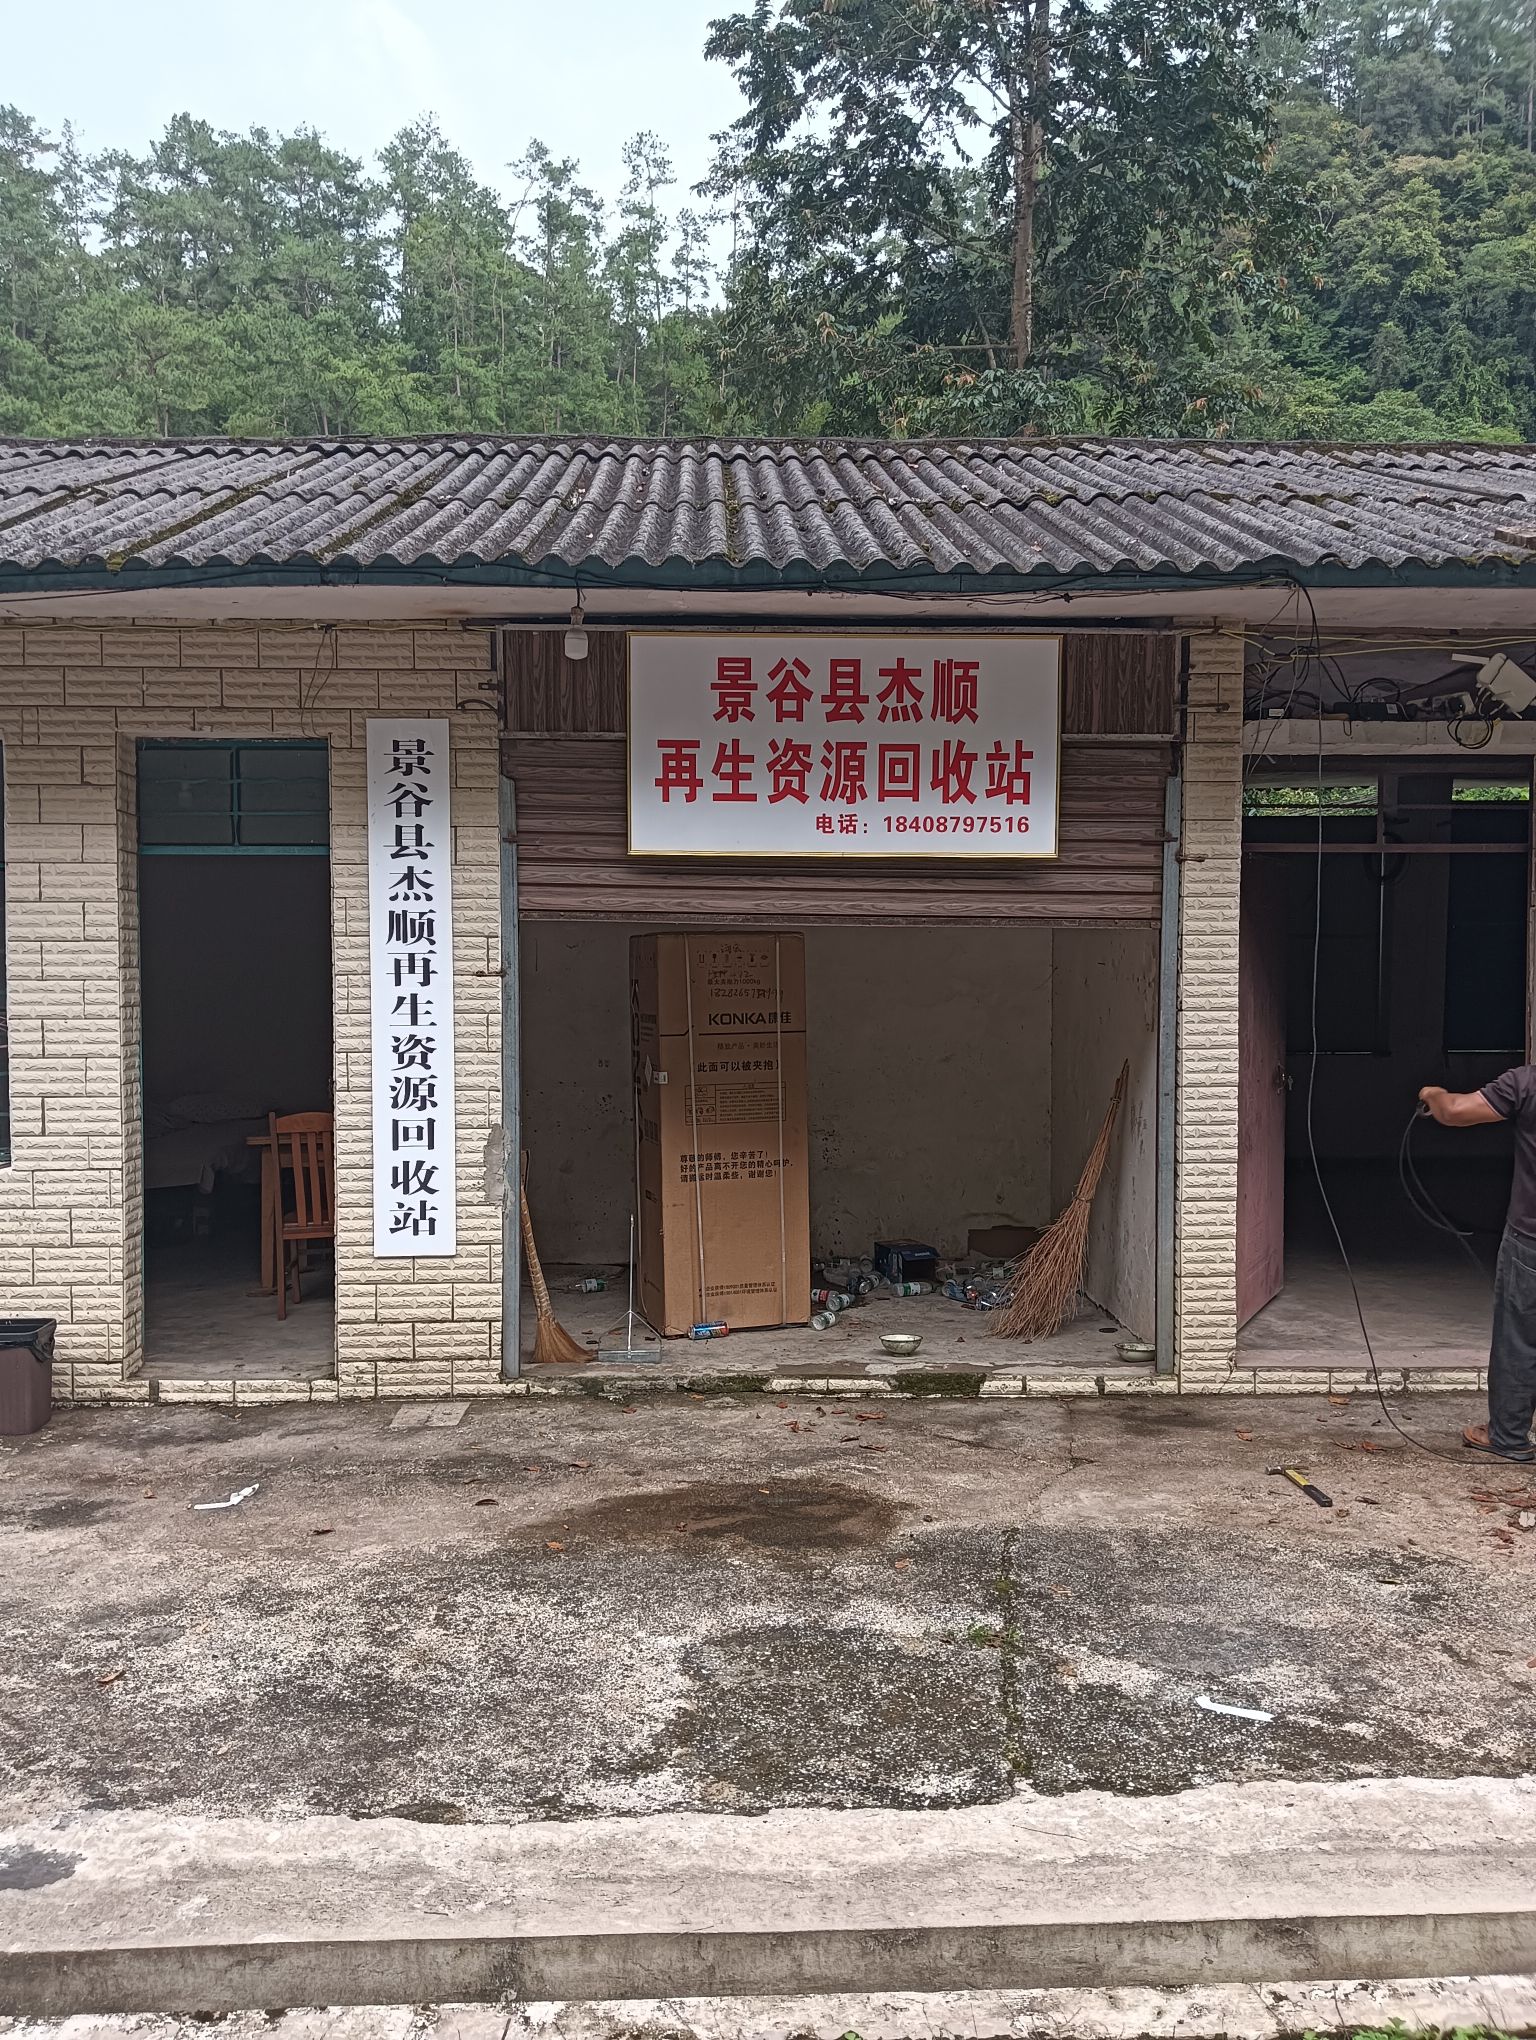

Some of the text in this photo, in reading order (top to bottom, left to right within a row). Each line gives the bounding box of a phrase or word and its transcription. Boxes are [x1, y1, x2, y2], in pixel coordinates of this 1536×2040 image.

[710, 656, 981, 725] 景谷县杰顺
[655, 738, 1034, 805] 再生资源回收站
[815, 813, 1030, 835] 电话：18408797516
[383, 739, 438, 1236] 景谷县杰顺再生资源回收站
[708, 1012, 766, 1026] KONKA
